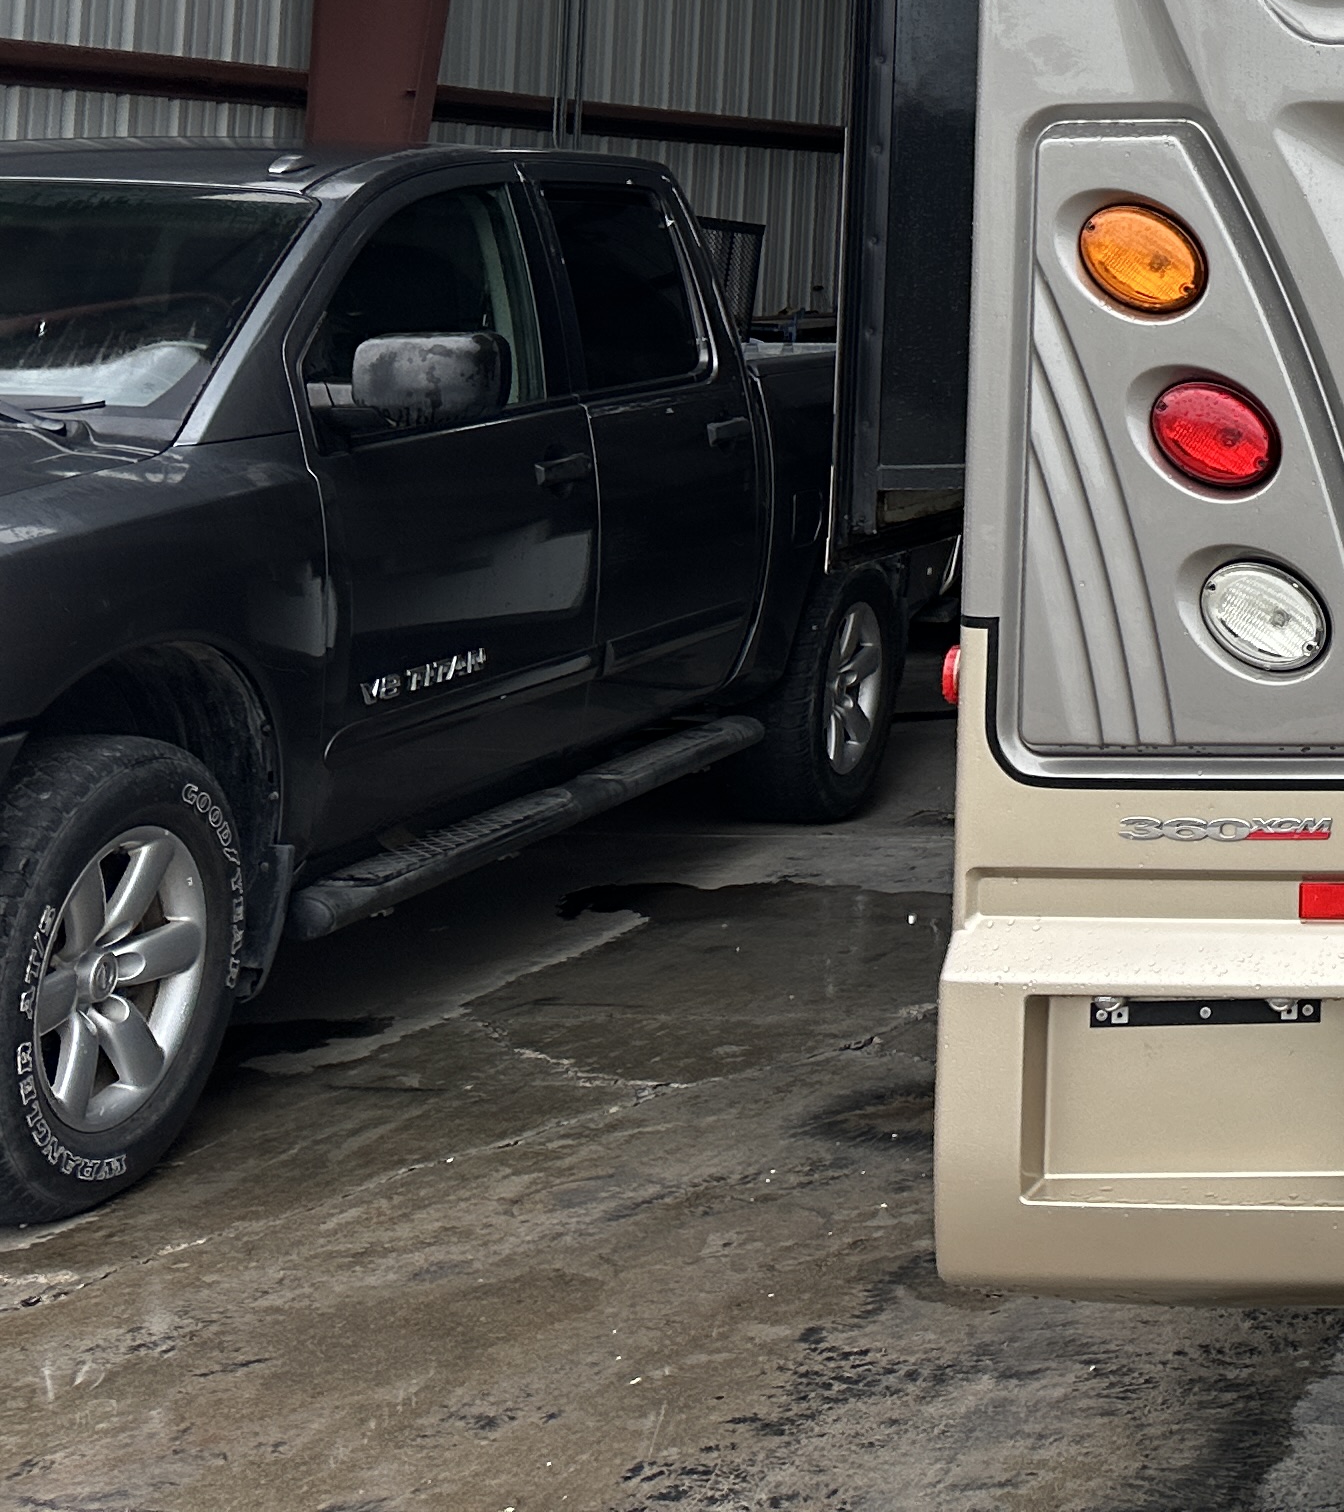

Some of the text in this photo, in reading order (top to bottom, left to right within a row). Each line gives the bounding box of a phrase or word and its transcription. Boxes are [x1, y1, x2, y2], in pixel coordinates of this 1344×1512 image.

[360, 648, 487, 705] V8 TITAN
[182, 783, 244, 989] GOODYEAR
[17, 904, 127, 1181] WRANGLER AT/S
